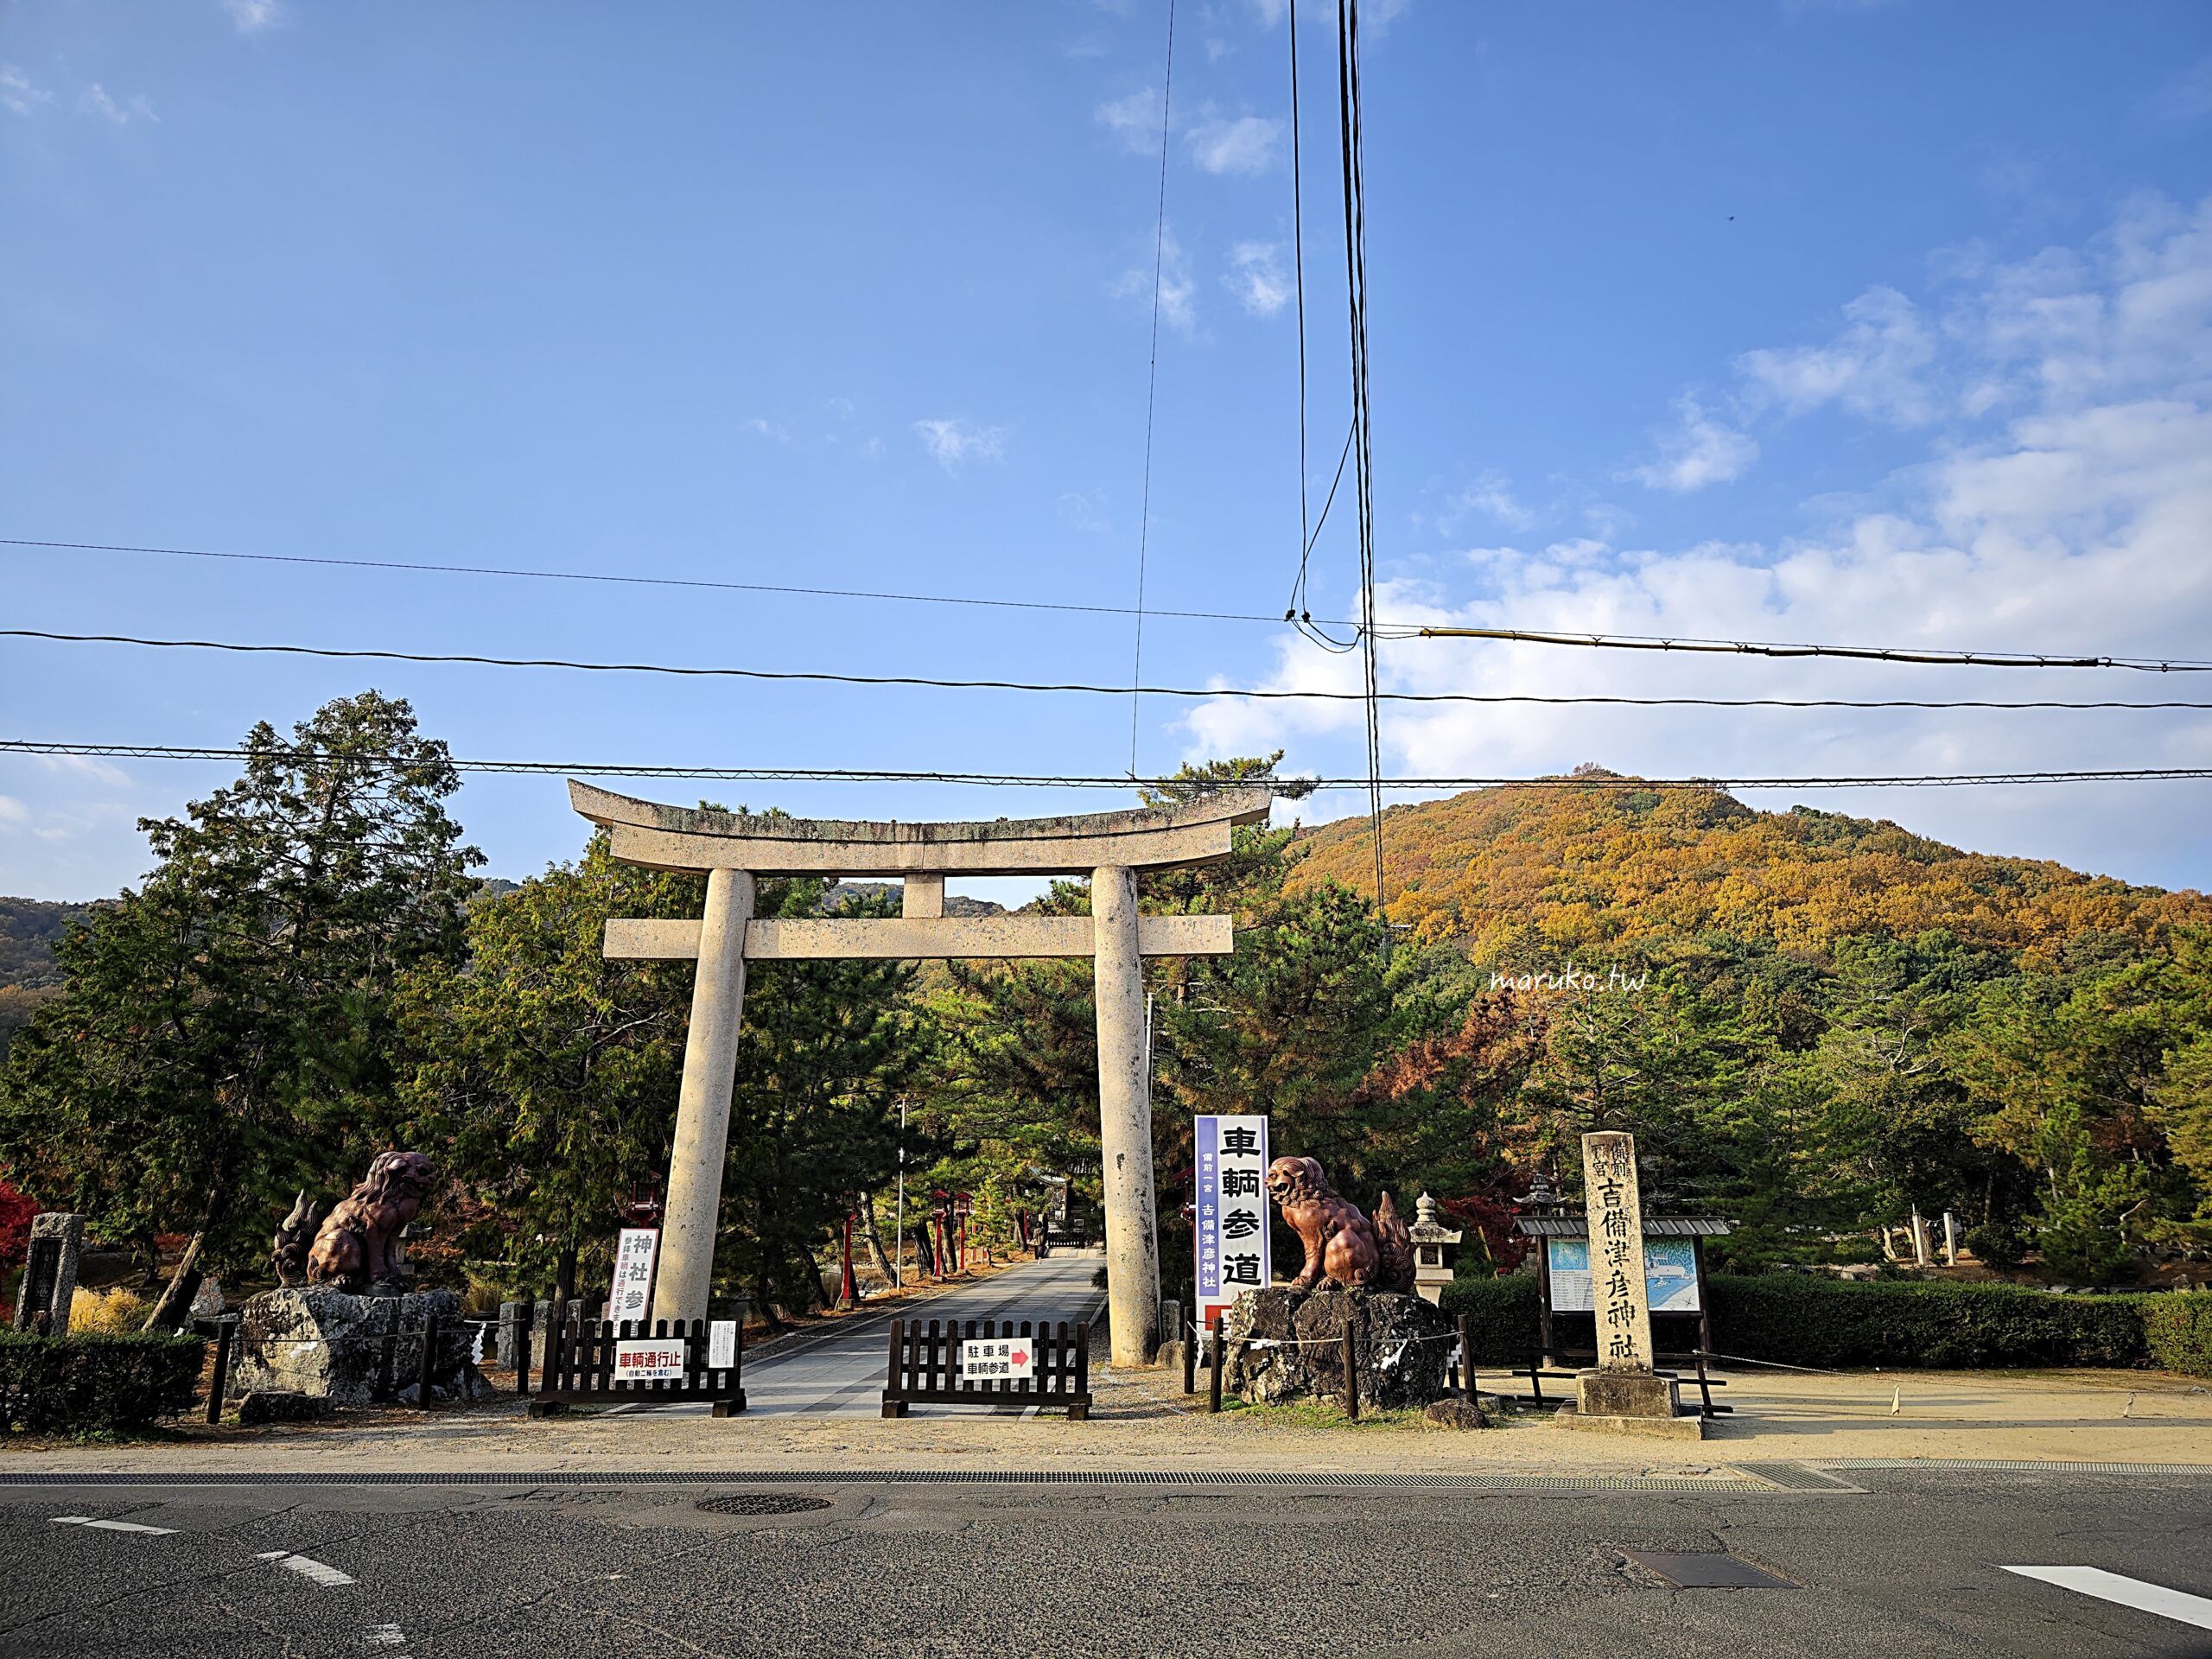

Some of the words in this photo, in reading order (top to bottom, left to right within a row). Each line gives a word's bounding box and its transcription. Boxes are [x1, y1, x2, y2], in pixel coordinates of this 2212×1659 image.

[1202, 1153, 1213, 1194] 備前一宮
[1219, 1126, 1262, 1286] 車輌参道
[619, 1351, 681, 1369] 車輌通行止
[967, 1344, 1009, 1358] 駐車場
[967, 1361, 1009, 1375] 車輌参道
